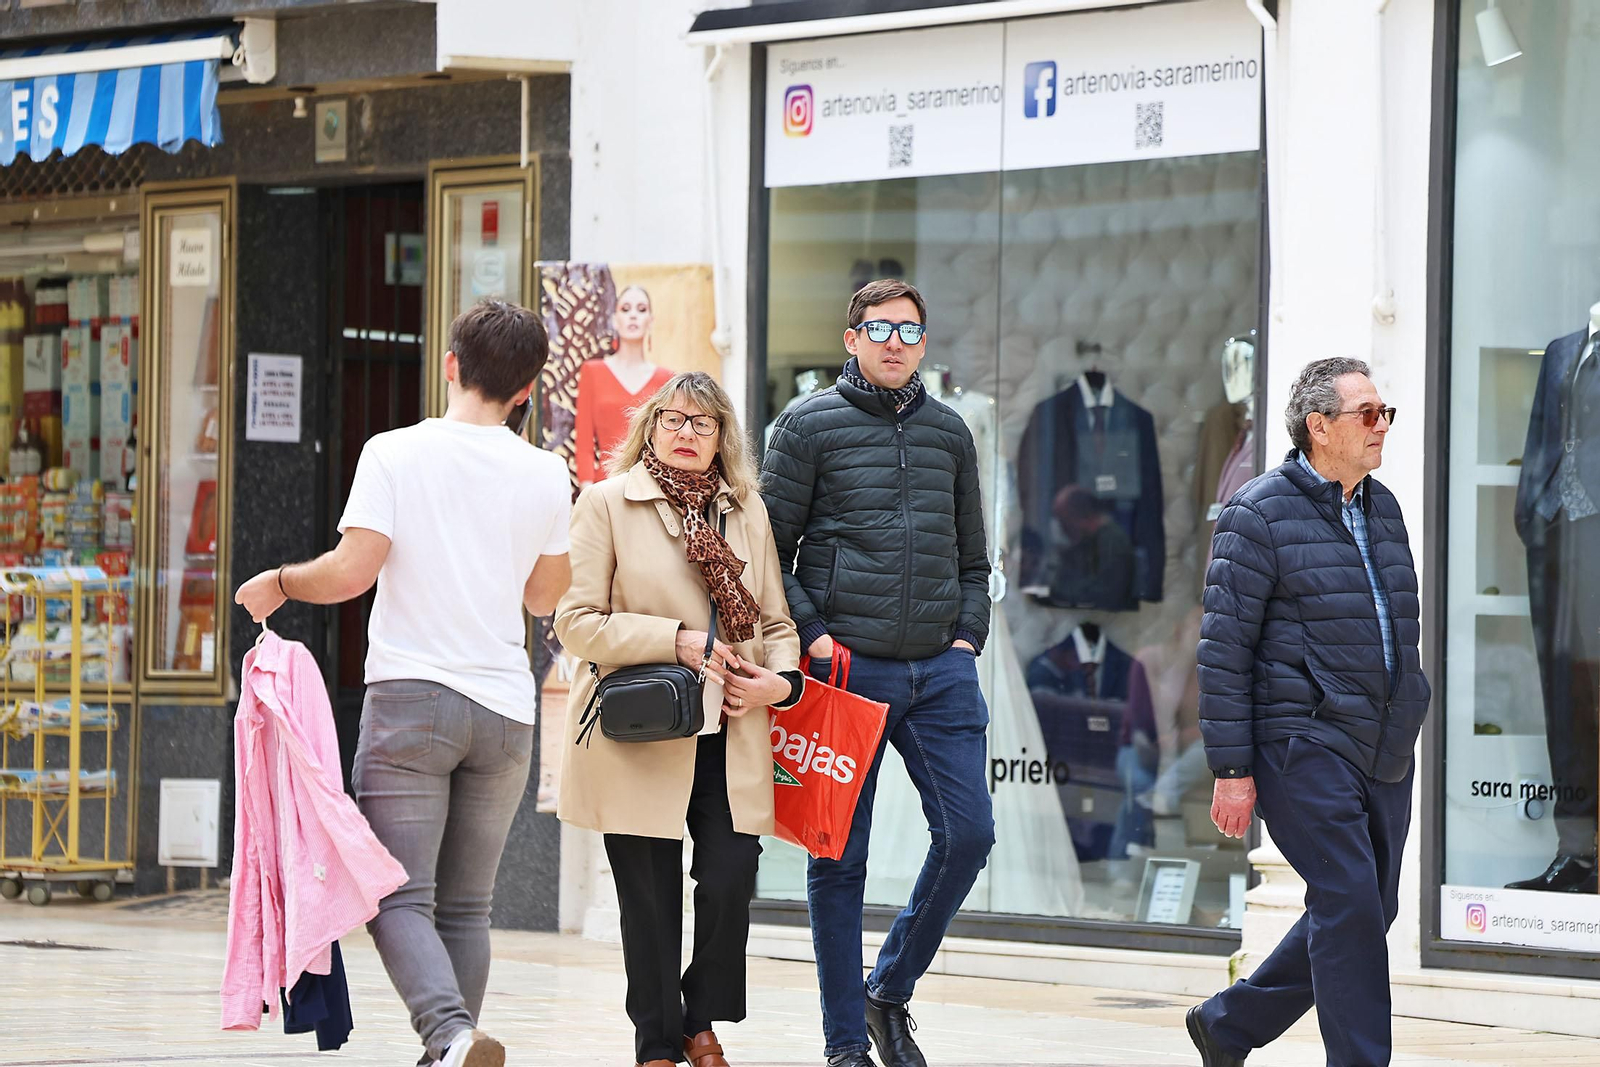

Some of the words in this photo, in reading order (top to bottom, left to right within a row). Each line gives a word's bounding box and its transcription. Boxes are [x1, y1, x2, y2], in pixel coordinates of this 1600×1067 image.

[1064, 55, 1258, 96] artenovia-saramerino
[0, 84, 59, 143] ES
[822, 80, 1002, 118] artenovia_saramerino
[991, 747, 1069, 794] prieto
[1471, 780, 1512, 798] sara
[1520, 778, 1587, 801] merino
